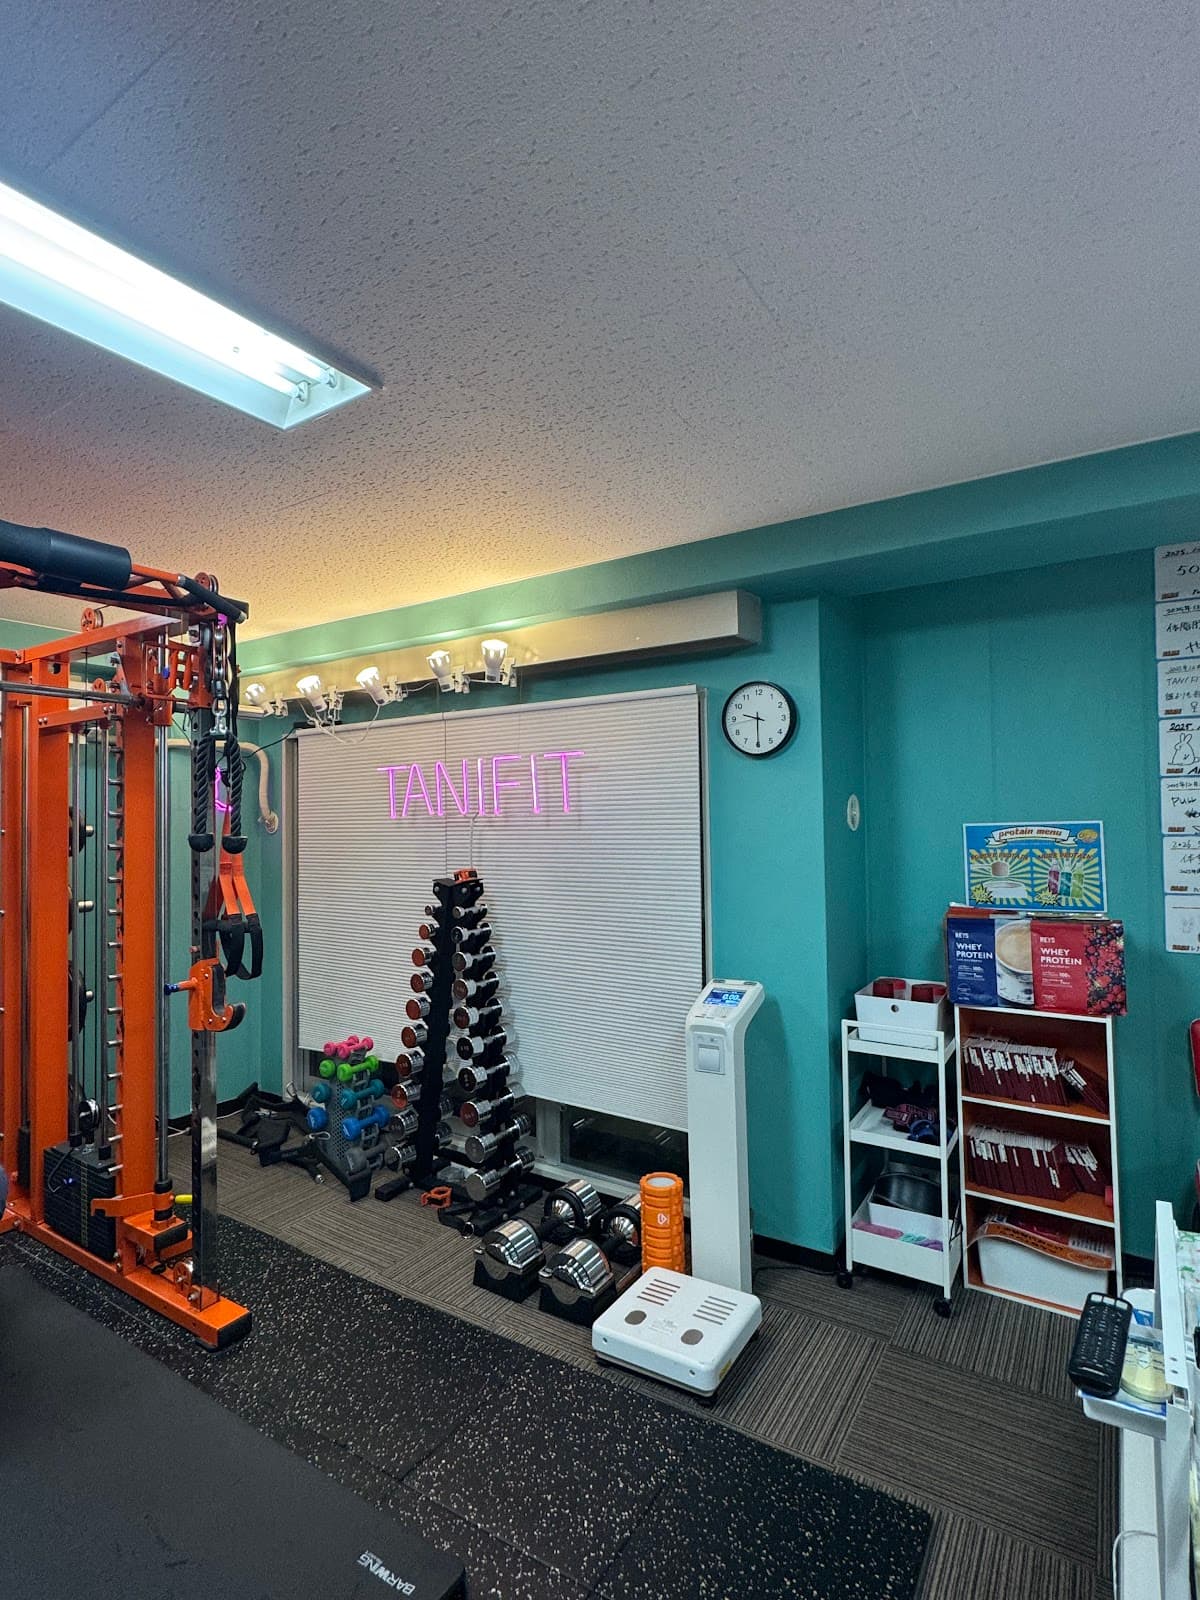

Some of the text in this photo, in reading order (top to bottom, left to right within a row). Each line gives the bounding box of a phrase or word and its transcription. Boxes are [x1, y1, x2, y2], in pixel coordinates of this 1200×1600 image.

[376, 750, 585, 819] TANIFIT
[998, 827, 1062, 840] protain menu
[956, 942, 982, 951] WHEY
[1040, 947, 1070, 956] WHEY
[956, 950, 993, 960] PROTEIN
[1040, 955, 1082, 965] PROTEIN
[356, 1551, 416, 1596] BARWING
